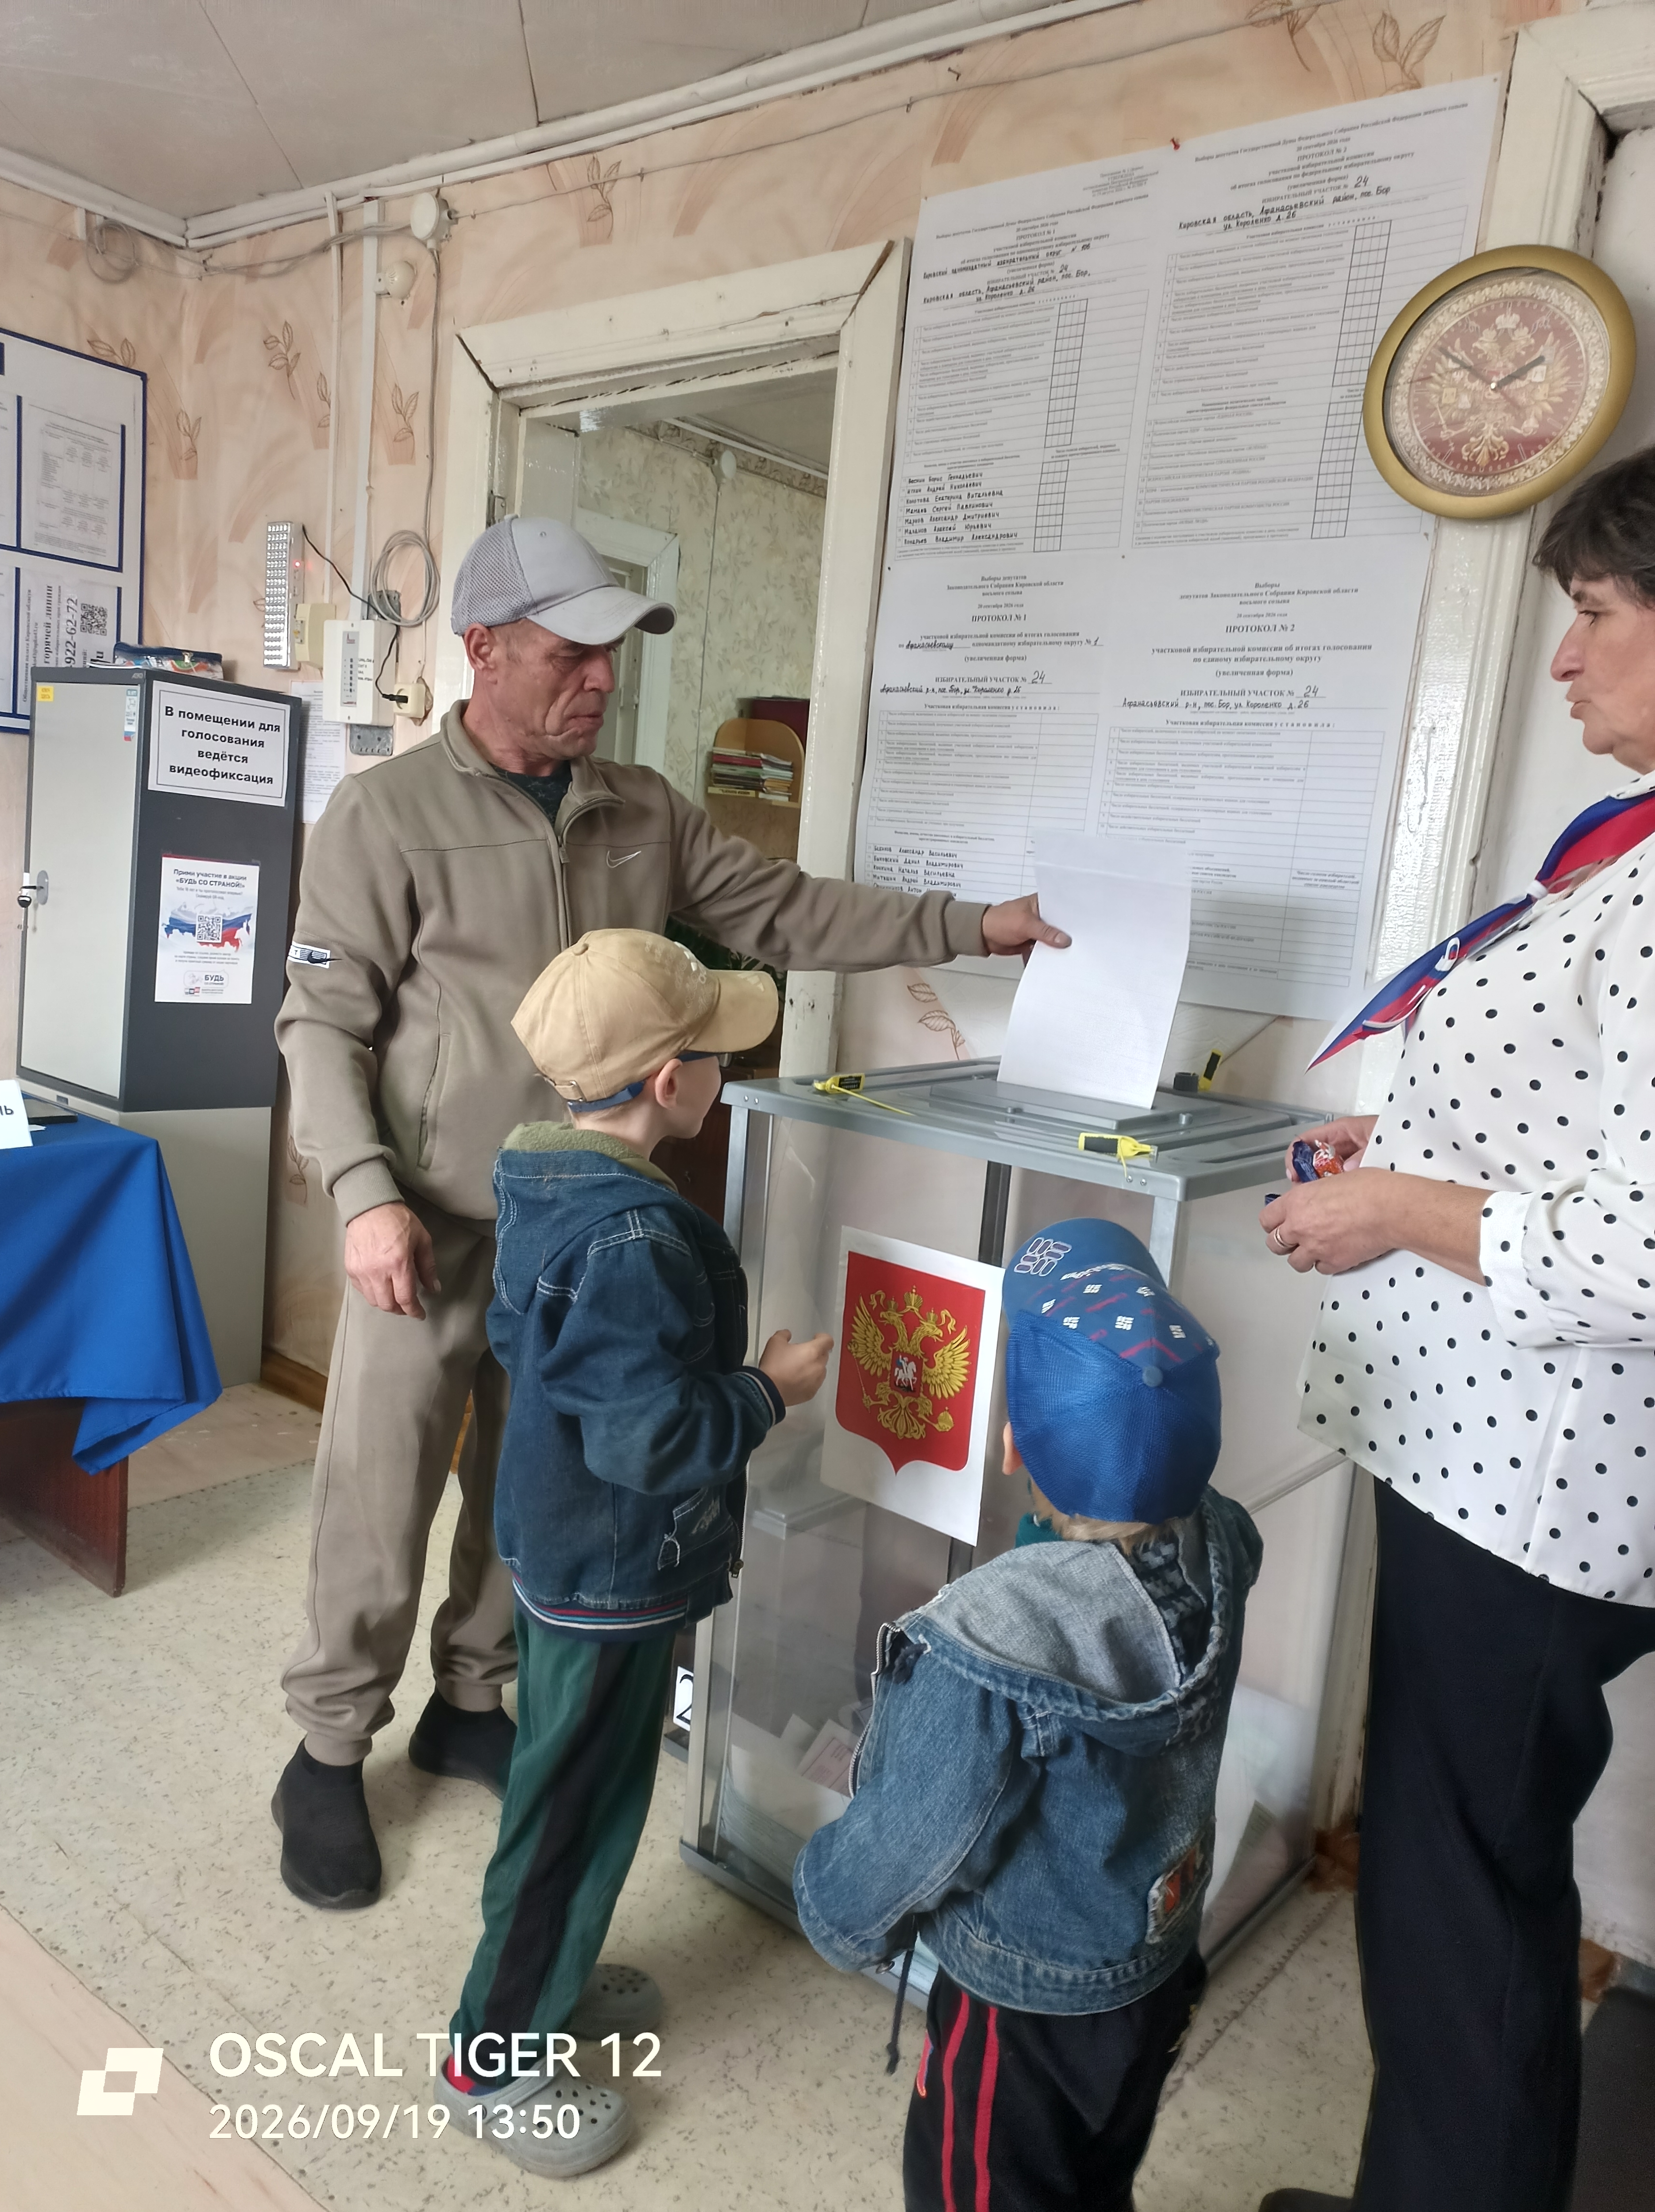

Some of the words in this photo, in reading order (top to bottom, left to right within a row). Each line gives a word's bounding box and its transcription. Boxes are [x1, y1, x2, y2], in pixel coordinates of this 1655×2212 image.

[1297, 150, 1335, 162] ПРОТОКОЛ
[1354, 175, 1369, 188] 24
[1178, 215, 1217, 231] Кировская
[1259, 195, 1324, 215] Афанасьевский
[1376, 186, 1391, 196] Бор
[1236, 215, 1271, 229] Короленко
[1286, 211, 1297, 219] 26
[1060, 264, 1069, 274] 24
[923, 294, 953, 304] Кировская
[985, 290, 1013, 302] Короленко
[927, 484, 945, 493] Андрей
[950, 481, 982, 490] Николаевич
[935, 494, 962, 502] Екатерина
[967, 490, 1003, 499] Витальевна
[932, 504, 951, 512] Сергей
[930, 514, 958, 523] Александр
[963, 512, 999, 521] Дмитриевич
[935, 535, 964, 543] Владимир
[971, 533, 1018, 541] Александрович
[64, 597, 78, 668] 922-62-72
[1226, 625, 1277, 633] ПРОТОКОЛ
[1279, 624, 1288, 632] №
[1290, 624, 1295, 632] 2
[44, 623, 52, 664] горячей
[1152, 645, 1191, 655] участковой
[1193, 644, 1246, 653] избирательной
[1285, 644, 1293, 652] об
[1234, 655, 1294, 663] избирательному
[1032, 671, 1046, 684] 24
[1267, 669, 1293, 677] форма)
[1303, 685, 1318, 697] 24
[1123, 697, 1179, 708] Афанасьевский
[1246, 700, 1282, 708] Короленко
[165, 706, 174, 716] В
[178, 710, 255, 728] помещении
[259, 722, 280, 732] для
[182, 729, 264, 748] голосования
[198, 750, 248, 763] ведётся
[170, 765, 273, 784] видеофиксация
[899, 848, 924, 856] Александр
[929, 850, 957, 858] Васильевич
[926, 860, 963, 869] Владимирович
[196, 871, 222, 879] участие
[209, 880, 245, 888] СТРАНОЙ!»
[924, 879, 961, 888] Владимирович
